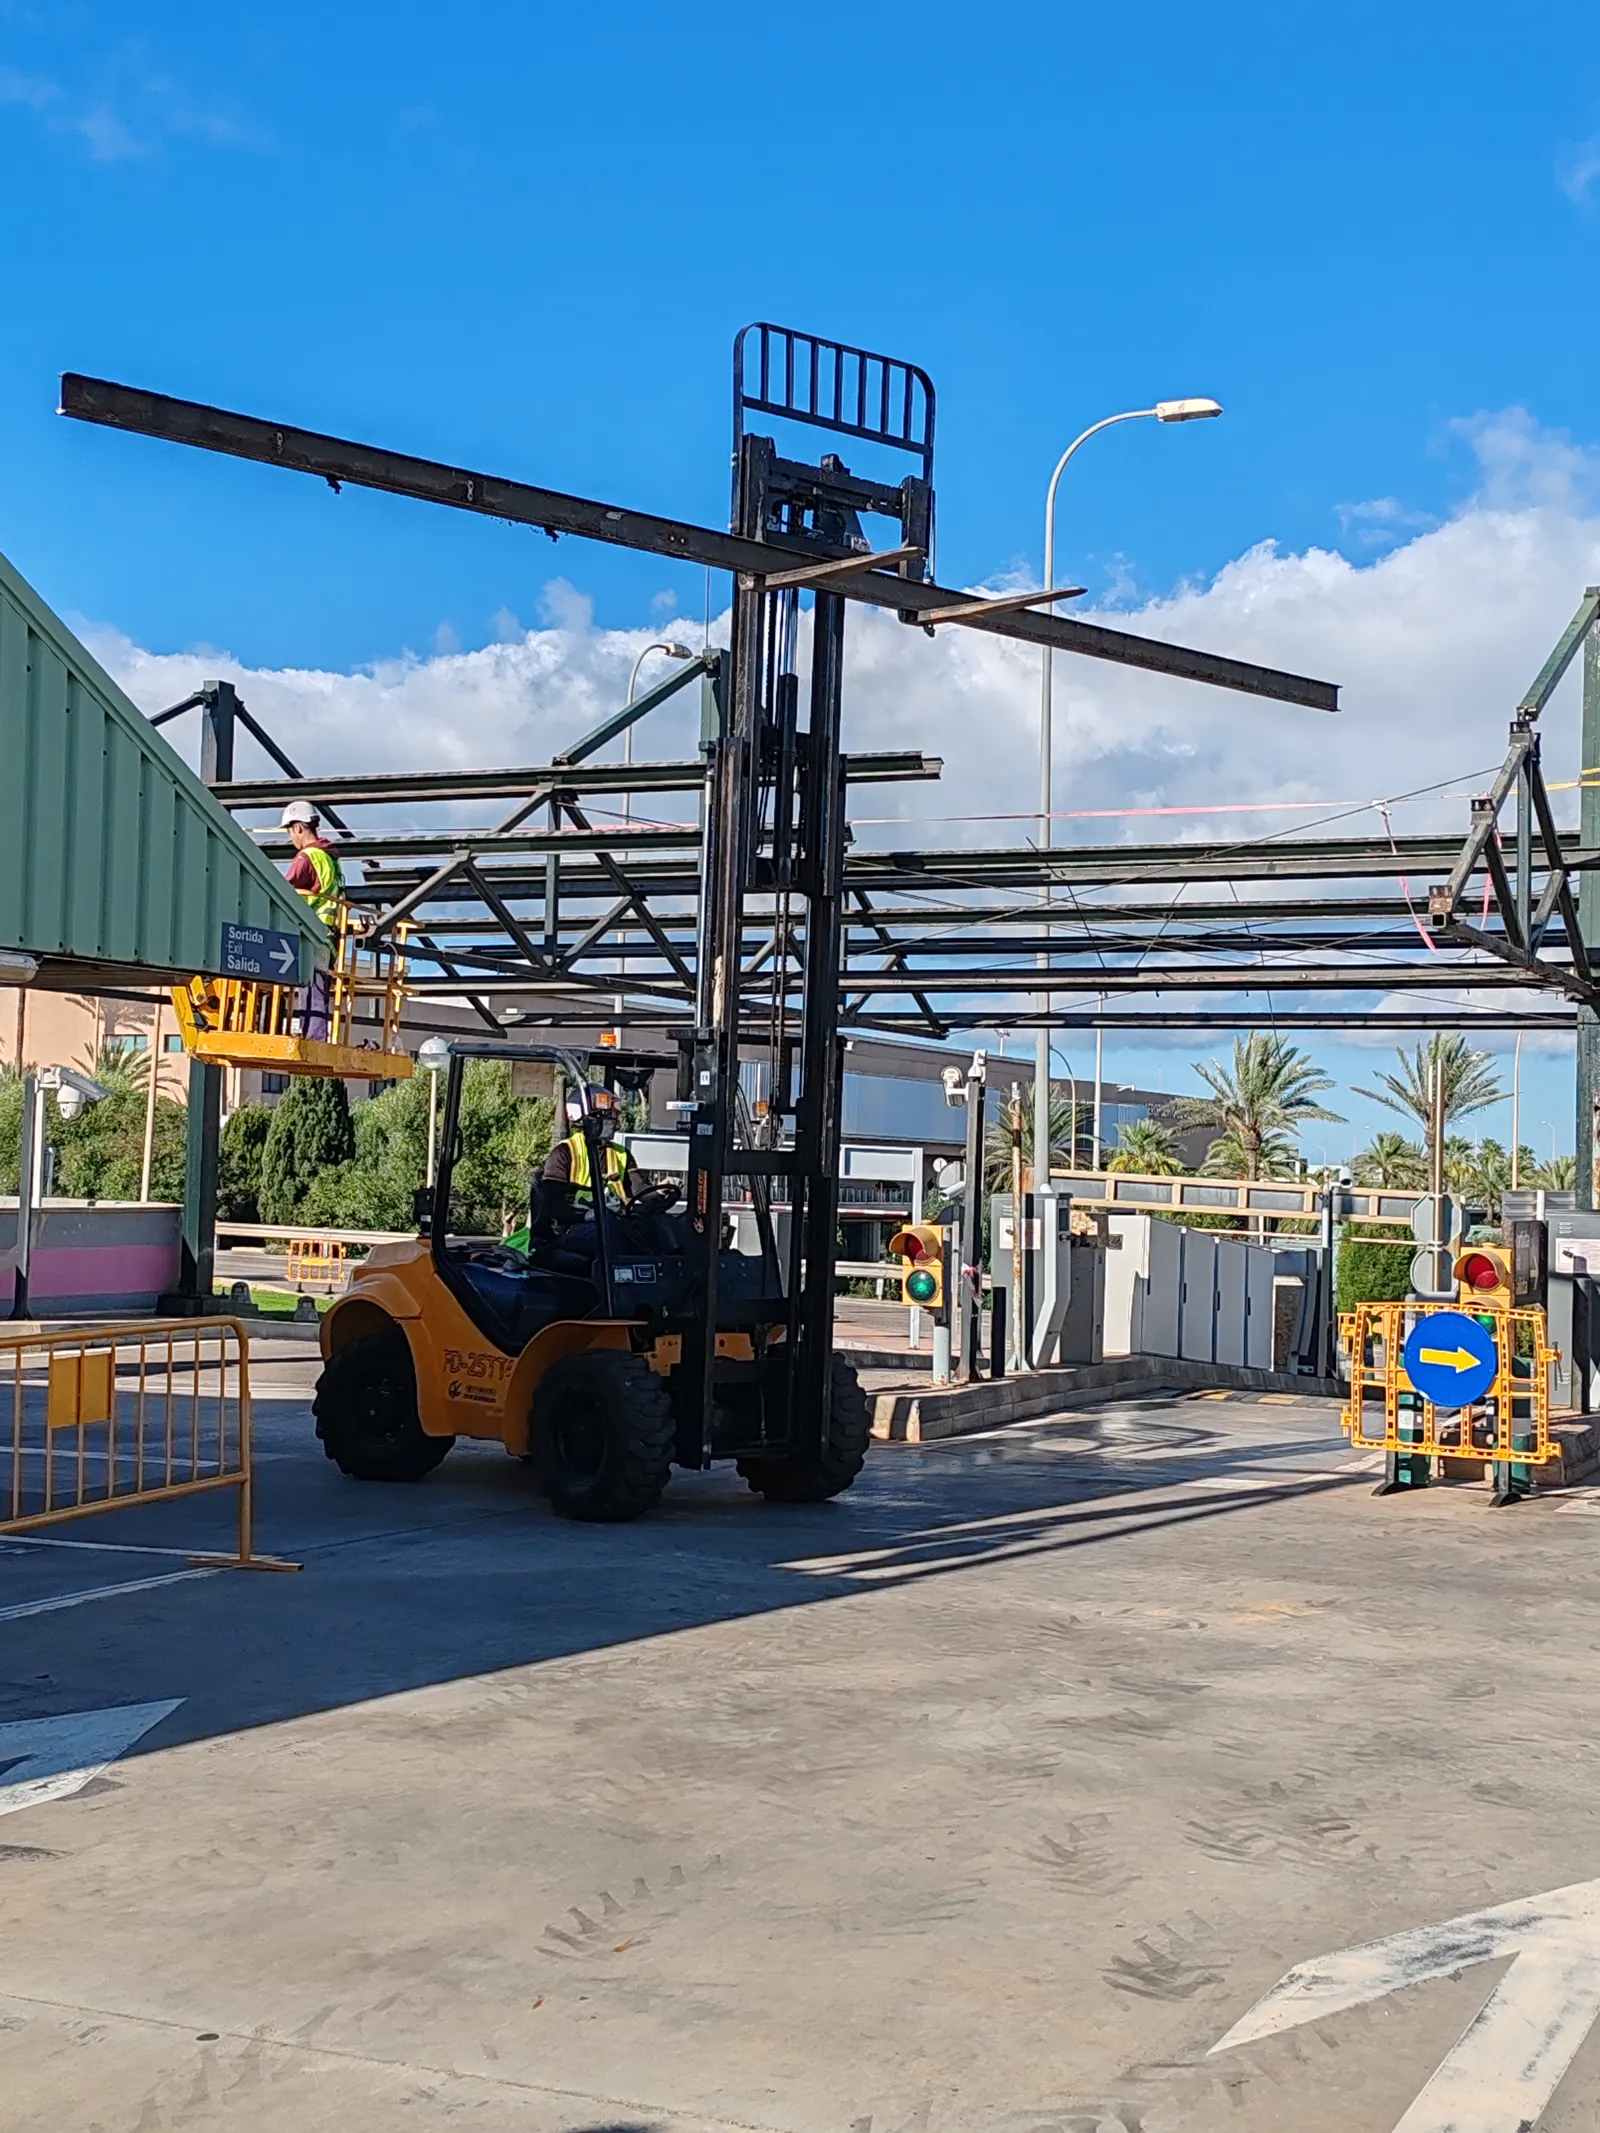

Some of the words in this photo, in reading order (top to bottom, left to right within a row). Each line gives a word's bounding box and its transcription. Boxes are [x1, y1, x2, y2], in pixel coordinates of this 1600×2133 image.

[228, 926, 264, 944] Sortida
[228, 941, 243, 955] Exit
[227, 955, 260, 973] Salida
